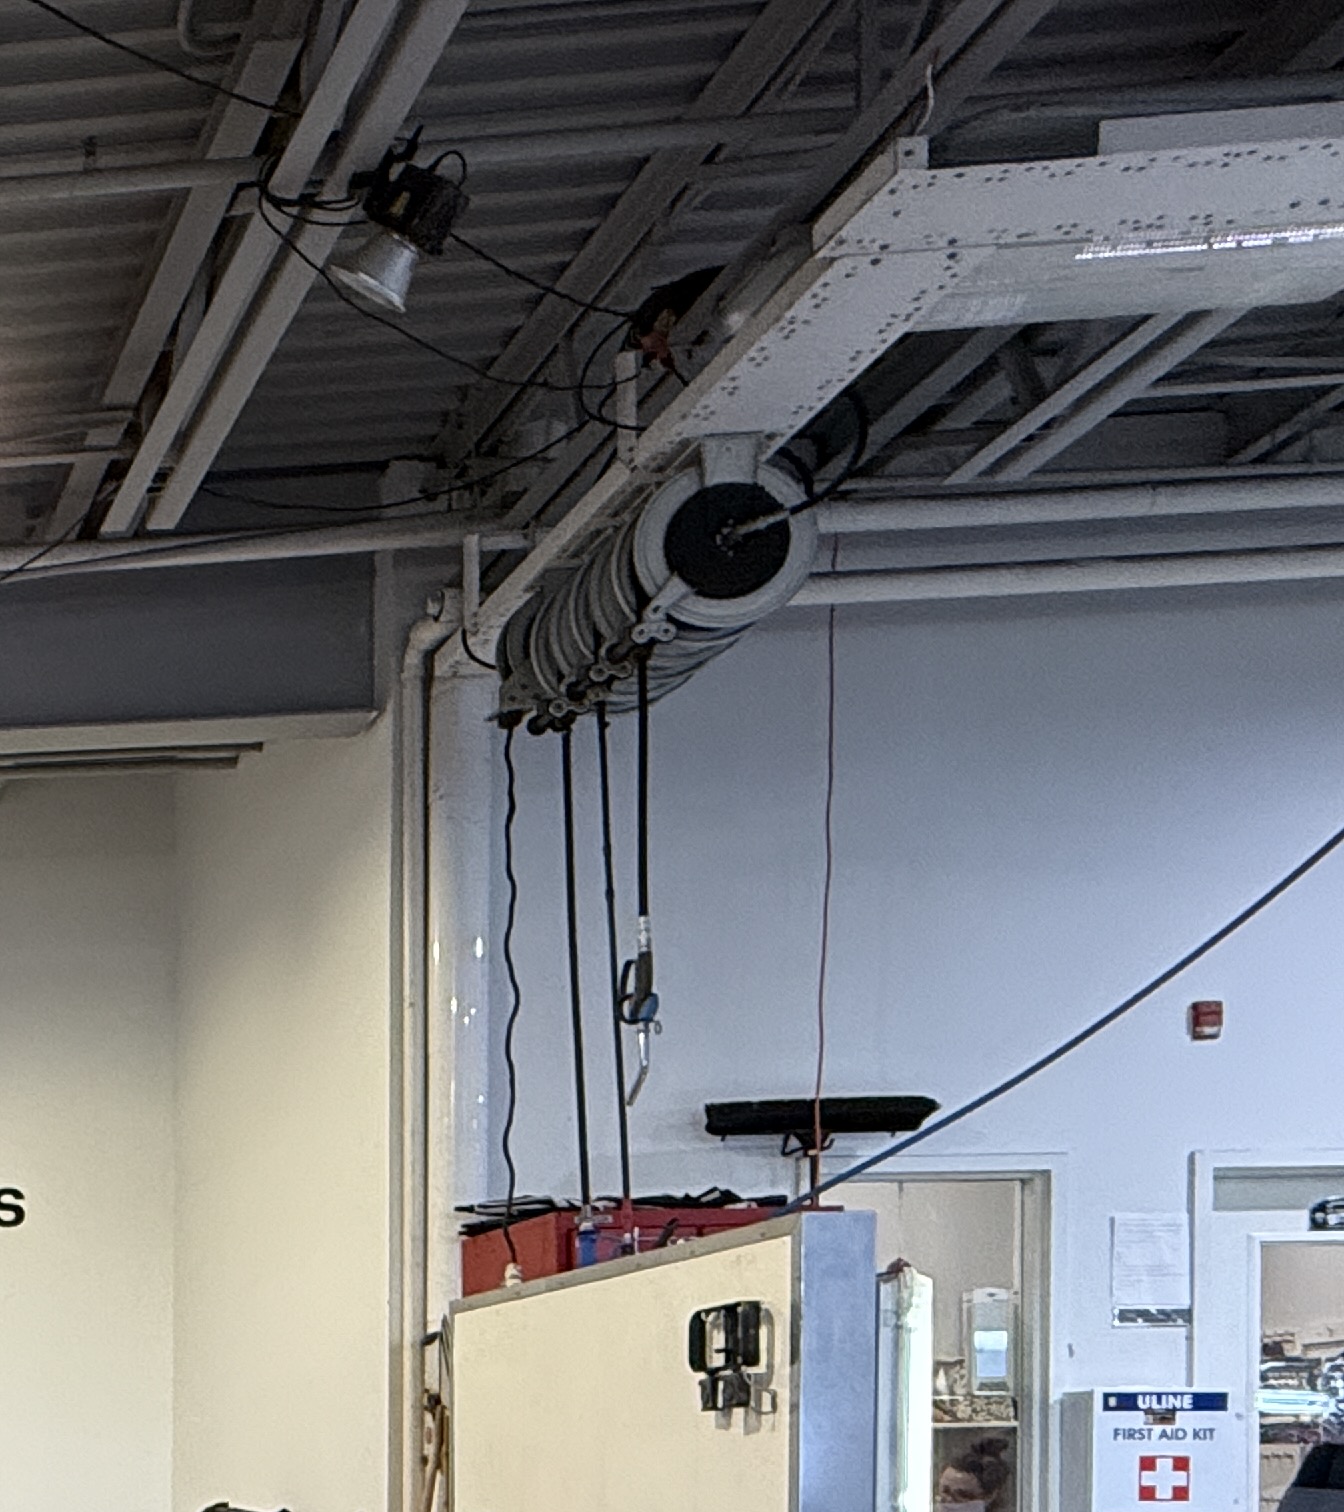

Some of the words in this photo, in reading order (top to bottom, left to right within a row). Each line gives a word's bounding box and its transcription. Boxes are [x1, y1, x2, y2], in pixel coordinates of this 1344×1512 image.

[1136, 1393, 1194, 1410] ULINE
[1112, 1427, 1153, 1441] FIRST
[1158, 1427, 1188, 1441] AID
[1192, 1427, 1216, 1441] KIT
